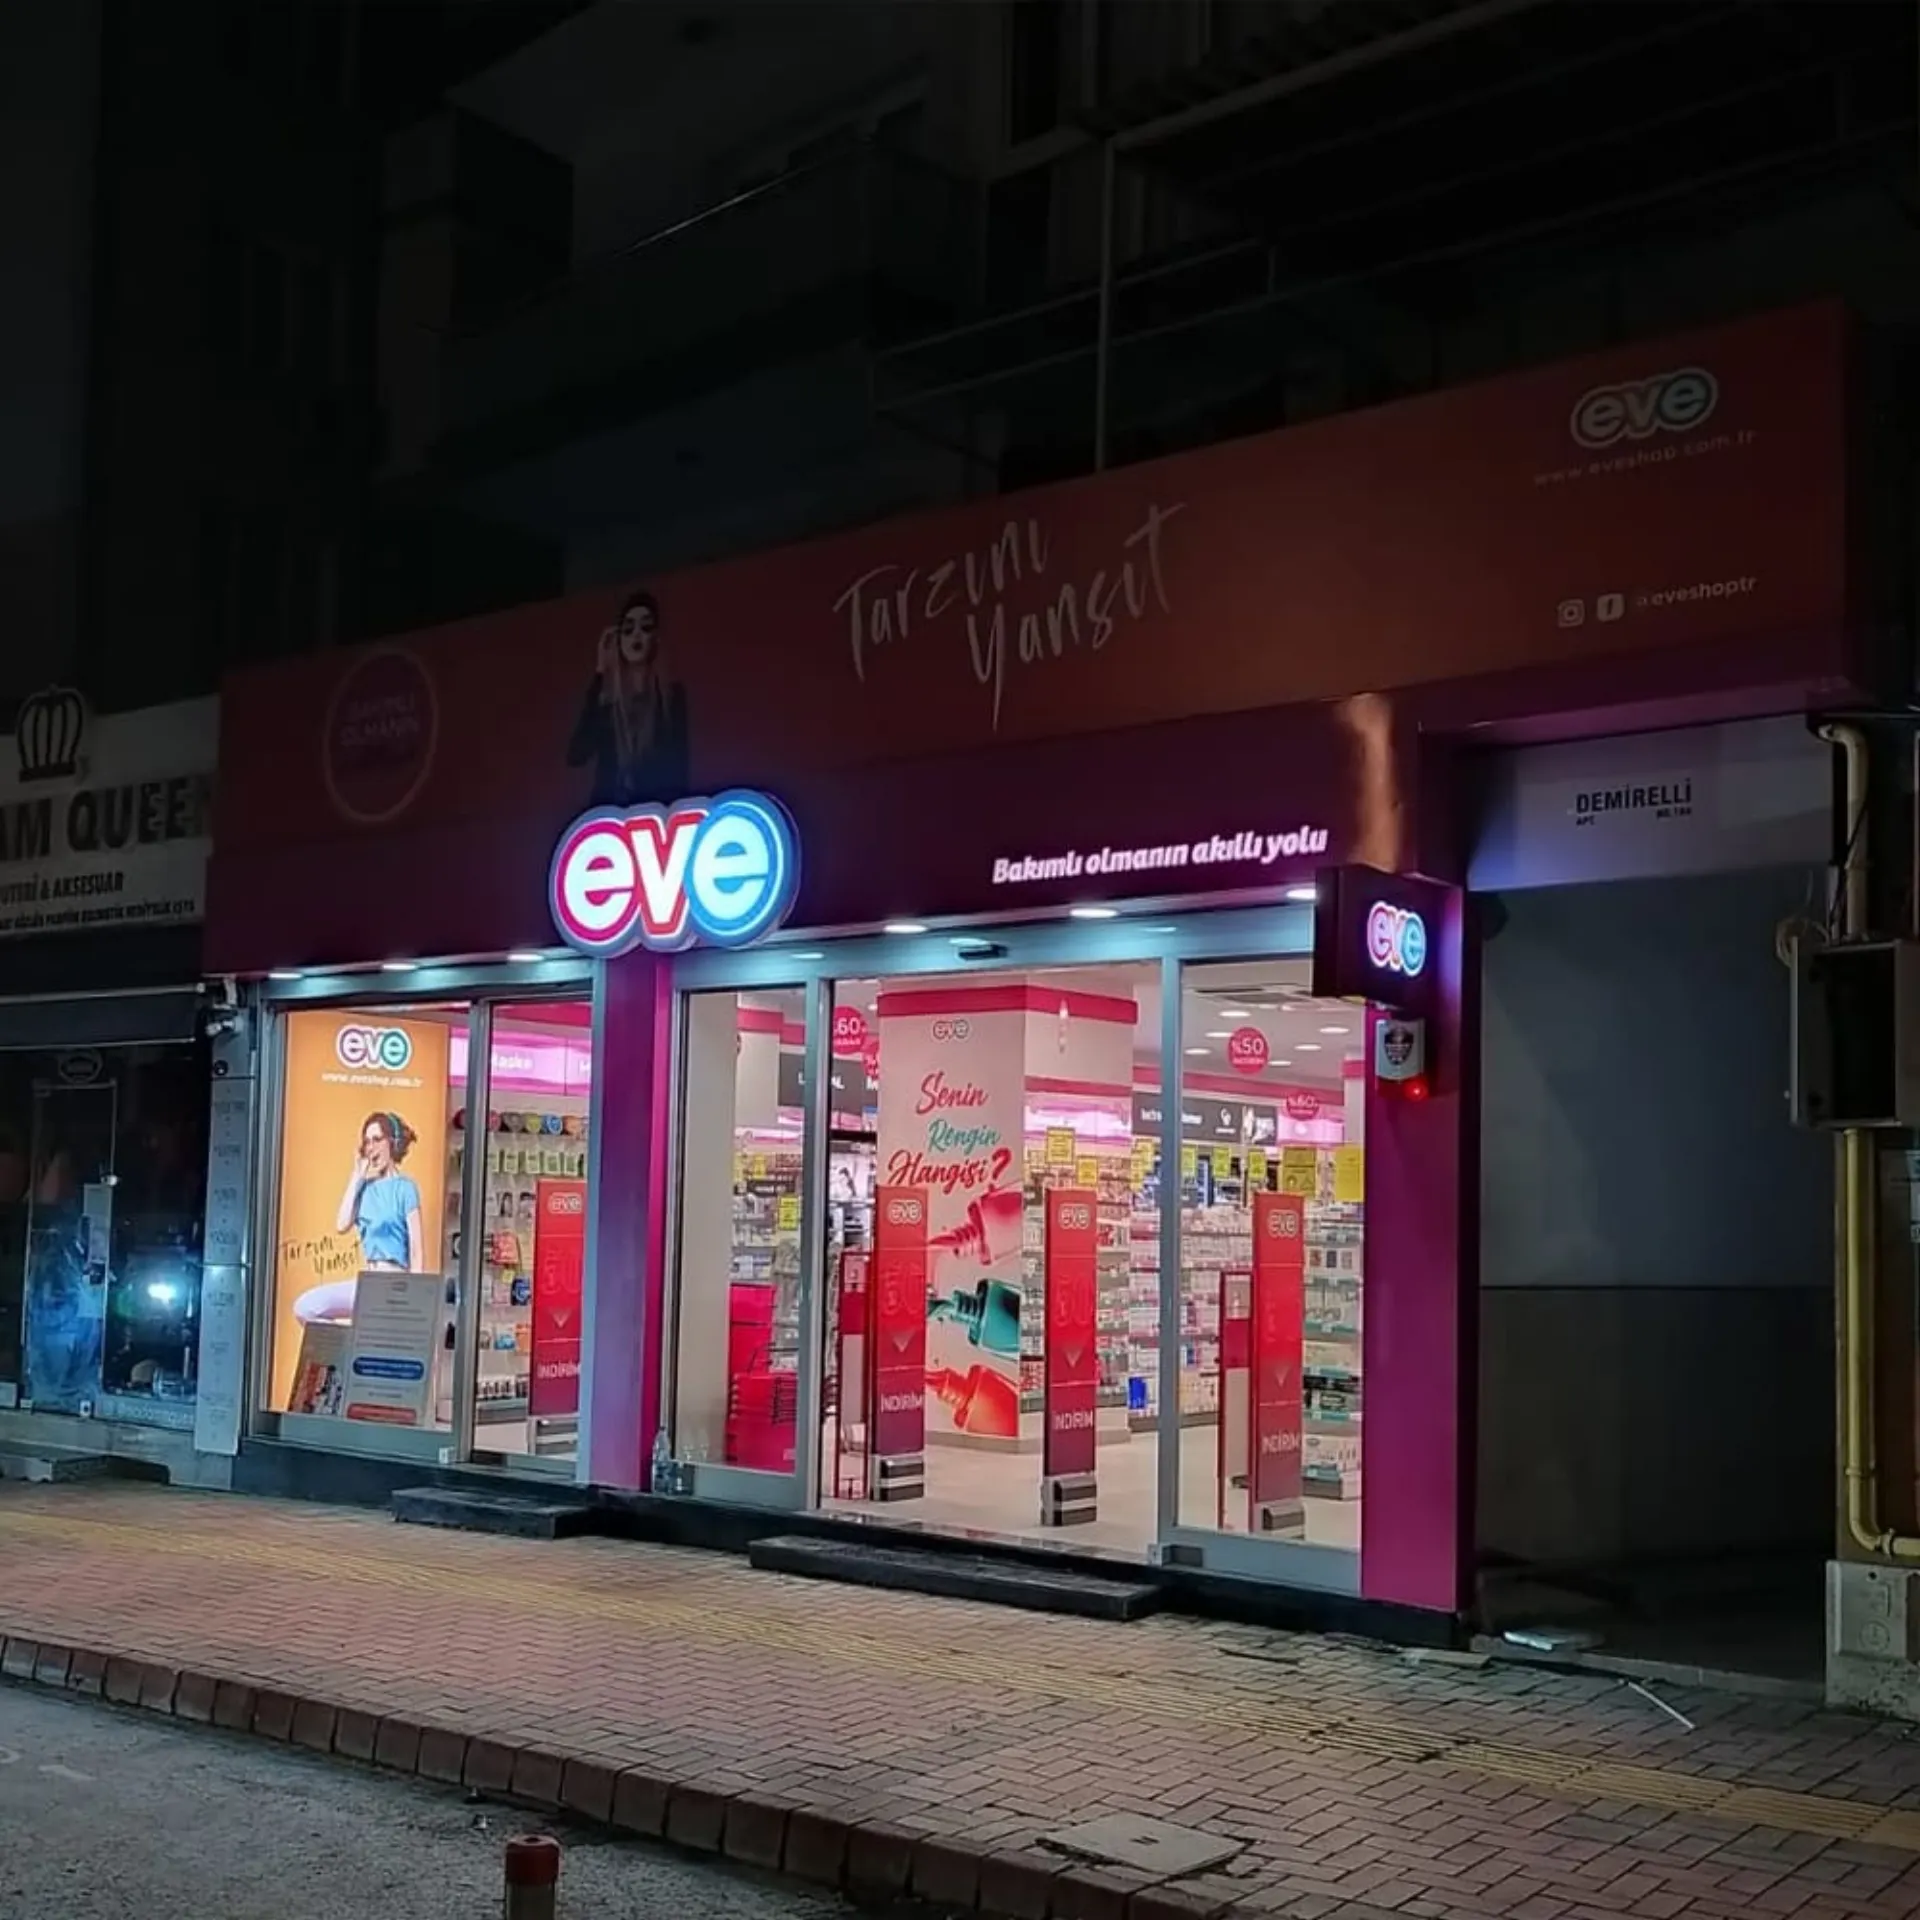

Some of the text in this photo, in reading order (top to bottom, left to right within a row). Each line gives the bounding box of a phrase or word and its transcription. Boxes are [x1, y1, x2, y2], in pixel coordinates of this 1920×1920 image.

[1575, 371, 1714, 444] eve
[556, 801, 783, 945] eve
[993, 825, 1328, 883] Bakımlı olmanın akıllı yolu
[1370, 904, 1425, 974] eve
[338, 1027, 410, 1068] eve
[933, 1019, 969, 1040] eve
[916, 1071, 989, 1115] Senin
[928, 1119, 999, 1155] Rengin
[888, 1199, 922, 1224] eve
[1059, 1203, 1089, 1229] eve
[1268, 1209, 1298, 1238] eve
